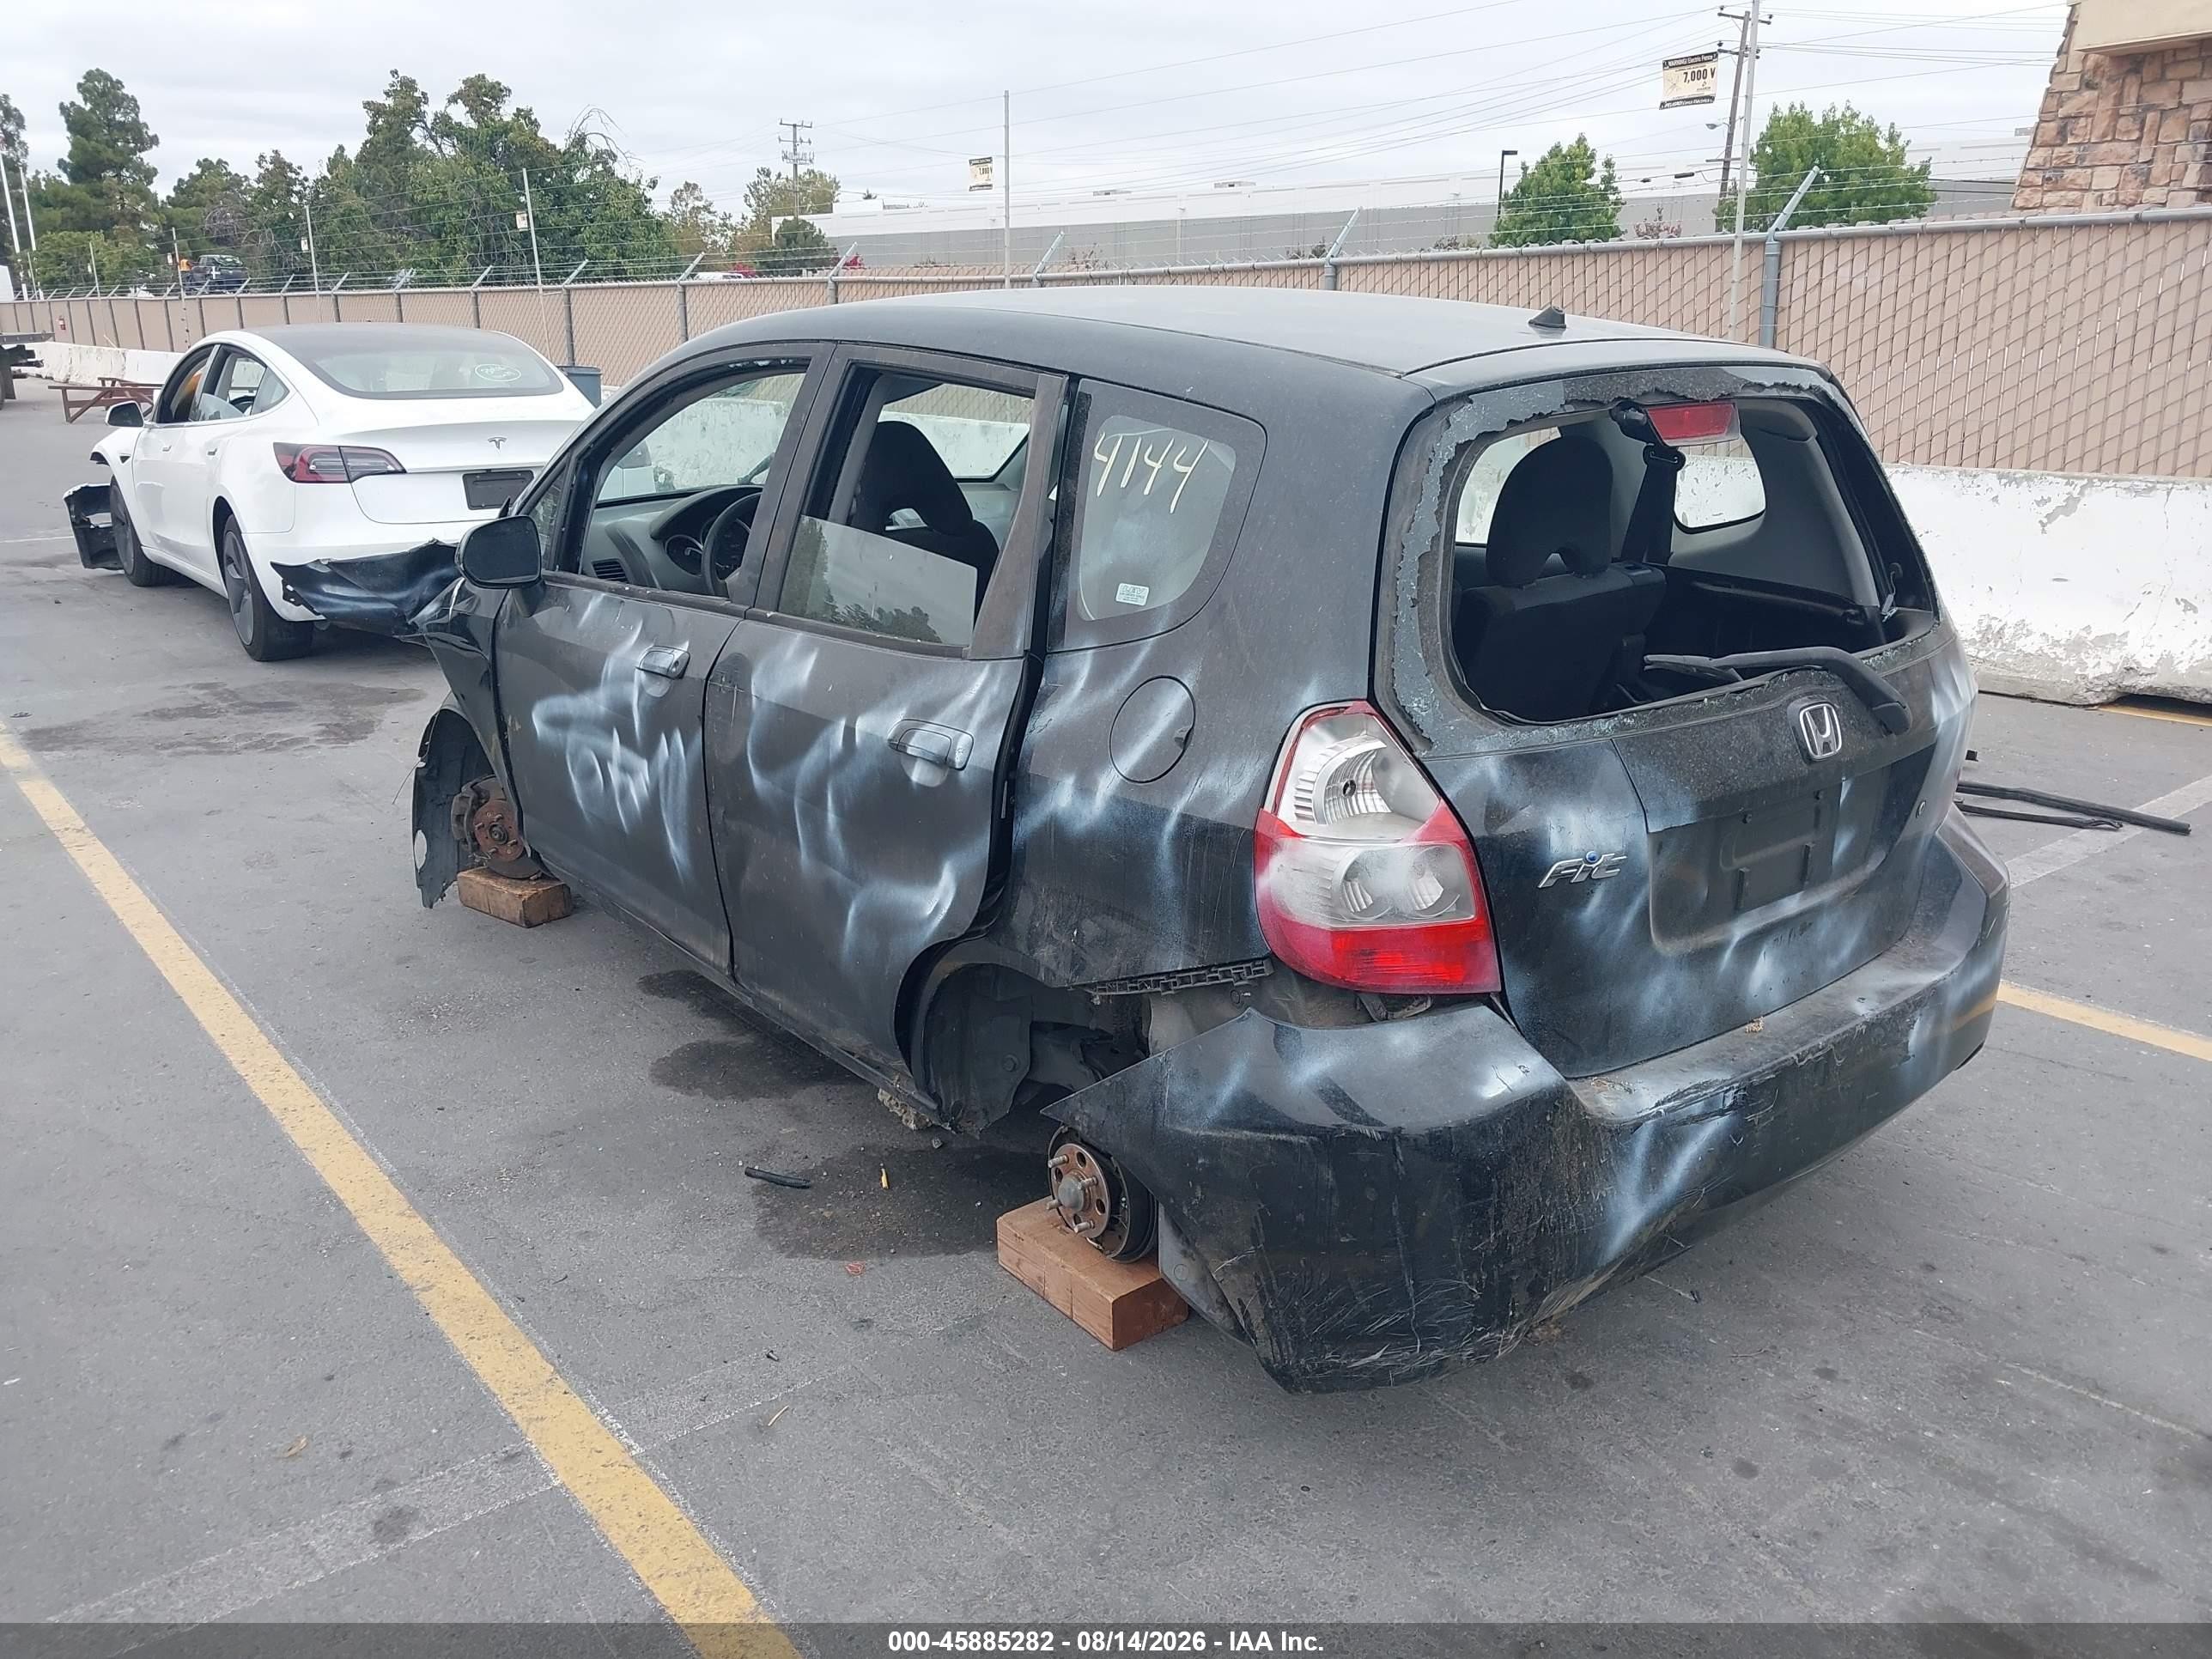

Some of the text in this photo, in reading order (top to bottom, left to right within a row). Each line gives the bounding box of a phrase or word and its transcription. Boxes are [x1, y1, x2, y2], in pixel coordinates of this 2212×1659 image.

[1683, 69, 1708, 84] 7,000
[1711, 67, 1716, 78] V
[1094, 432, 1209, 514] 4144
[1538, 851, 1626, 888] Fit
